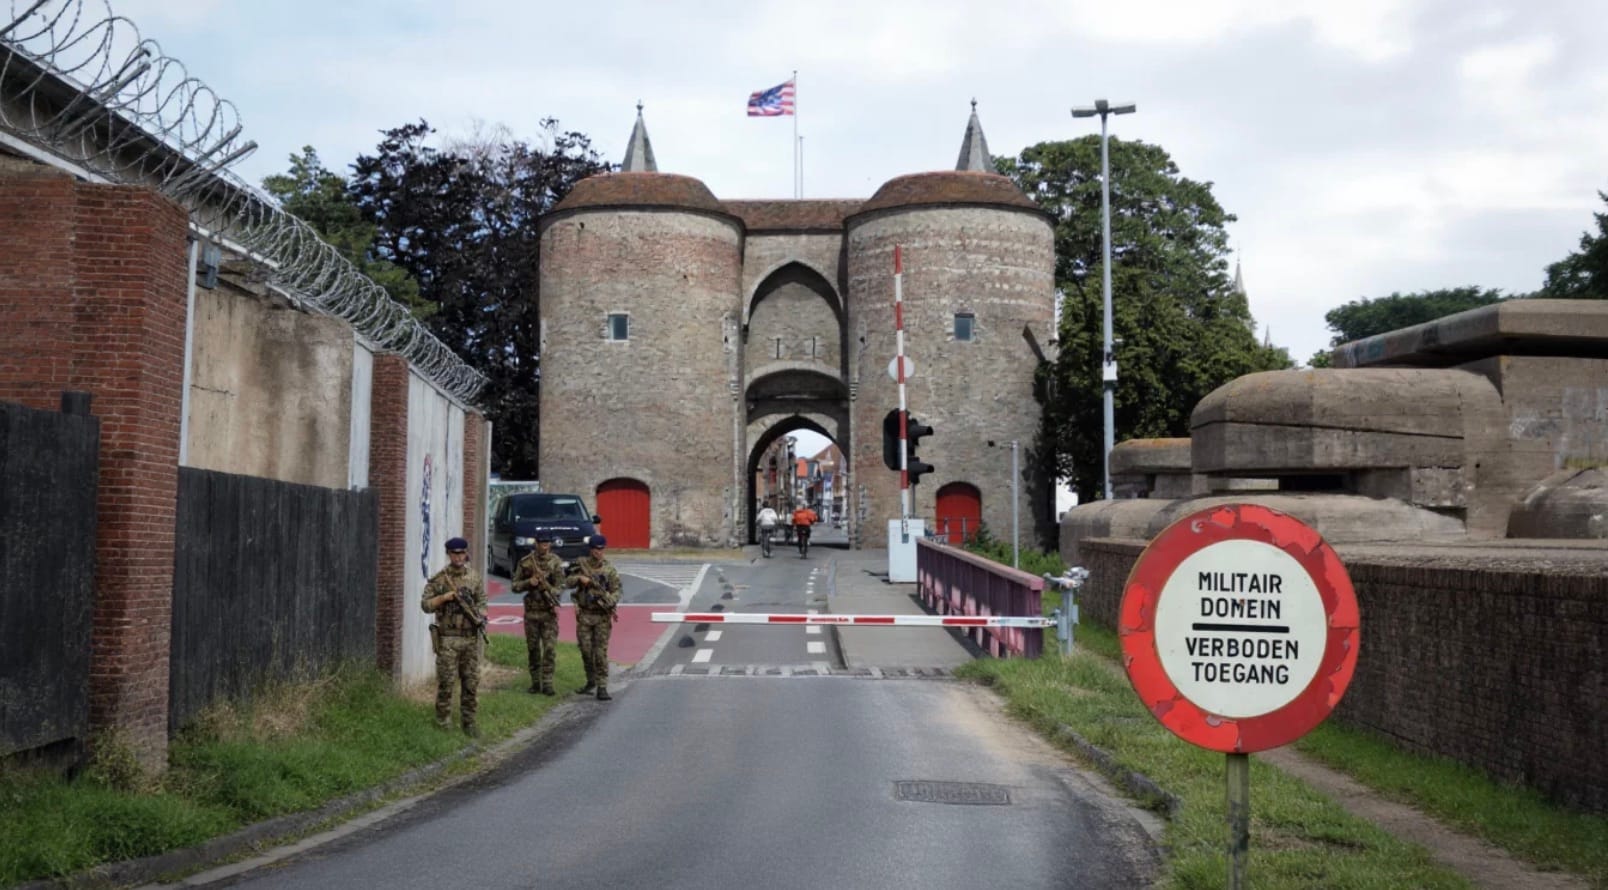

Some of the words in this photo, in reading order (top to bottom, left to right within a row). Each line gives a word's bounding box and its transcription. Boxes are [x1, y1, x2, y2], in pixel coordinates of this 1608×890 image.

[1198, 571, 1282, 593] MILITAIR
[1200, 597, 1280, 619] DOMEIN
[1185, 637, 1298, 659] VERBODEN
[1191, 661, 1289, 685] TOEGANG
